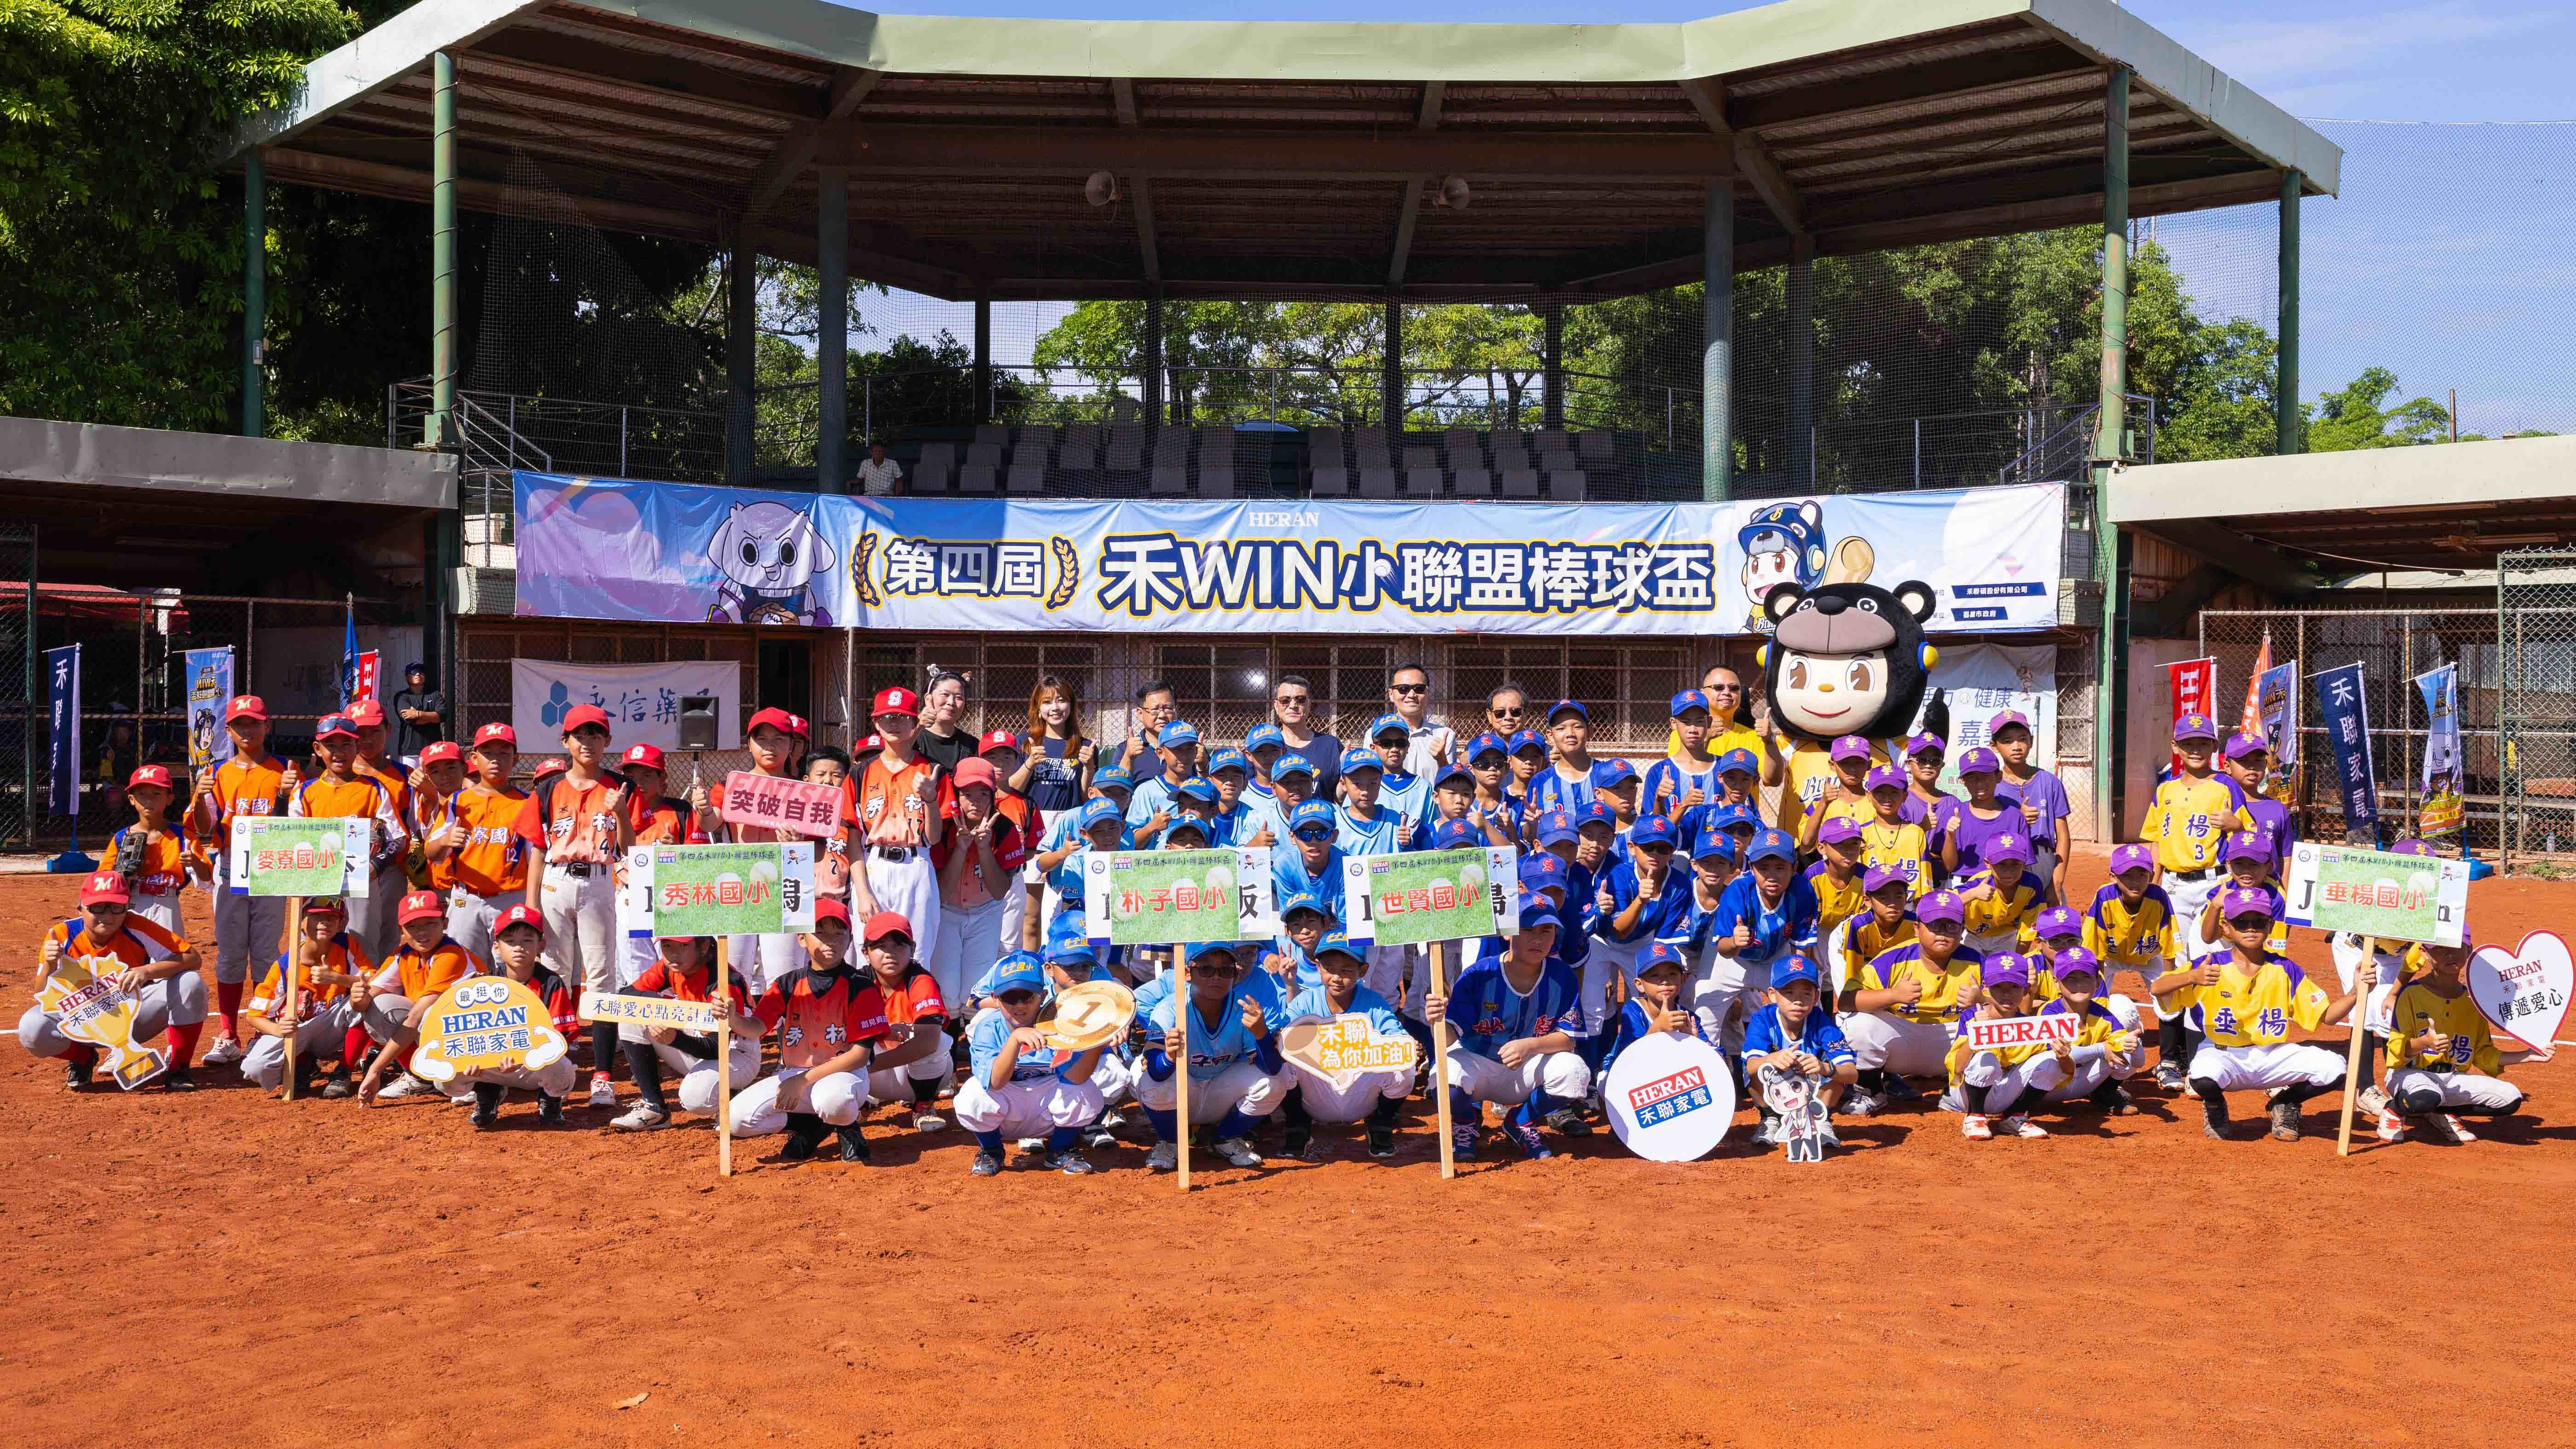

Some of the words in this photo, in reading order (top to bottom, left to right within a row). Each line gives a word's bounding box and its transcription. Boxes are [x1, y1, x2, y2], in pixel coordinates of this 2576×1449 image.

[1249, 511, 1319, 527] HERAN
[884, 537, 1046, 599] 第四屆
[1101, 534, 1715, 611] 禾WIN小聯盟棒球盃
[587, 685, 709, 724] 永信藥
[1974, 686, 2014, 708] 健康
[2330, 677, 2368, 817] 禾聯家電
[730, 790, 834, 826] 突破自我
[1184, 813, 1197, 823] P
[257, 848, 336, 870] 麥寮國小
[599, 838, 609, 855] 4
[2194, 844, 2205, 862] 3
[664, 880, 770, 906] 秀林國小
[1122, 887, 1226, 913] 朴子國小
[1381, 883, 1481, 915] 世賢國小
[2326, 881, 2426, 910] 垂楊國小
[2497, 960, 2542, 982] HERAN
[2503, 975, 2546, 995] 禾聯家電
[58, 973, 119, 1013] HERAN
[460, 986, 505, 1002] 最挺你
[2498, 988, 2563, 1023] 傳遞愛心
[69, 989, 130, 1027] 禾聯家電
[442, 1006, 527, 1034] HERAN
[2213, 1006, 2287, 1037] 垂楊
[446, 1029, 530, 1057] 禾聯家電
[1319, 1021, 1366, 1045] 禾聯
[1973, 1017, 2077, 1048] HERAN
[1321, 1043, 1411, 1068] 為你加油!
[1632, 1069, 1701, 1107] HERAN
[1639, 1088, 1709, 1125] 禾聯家電
